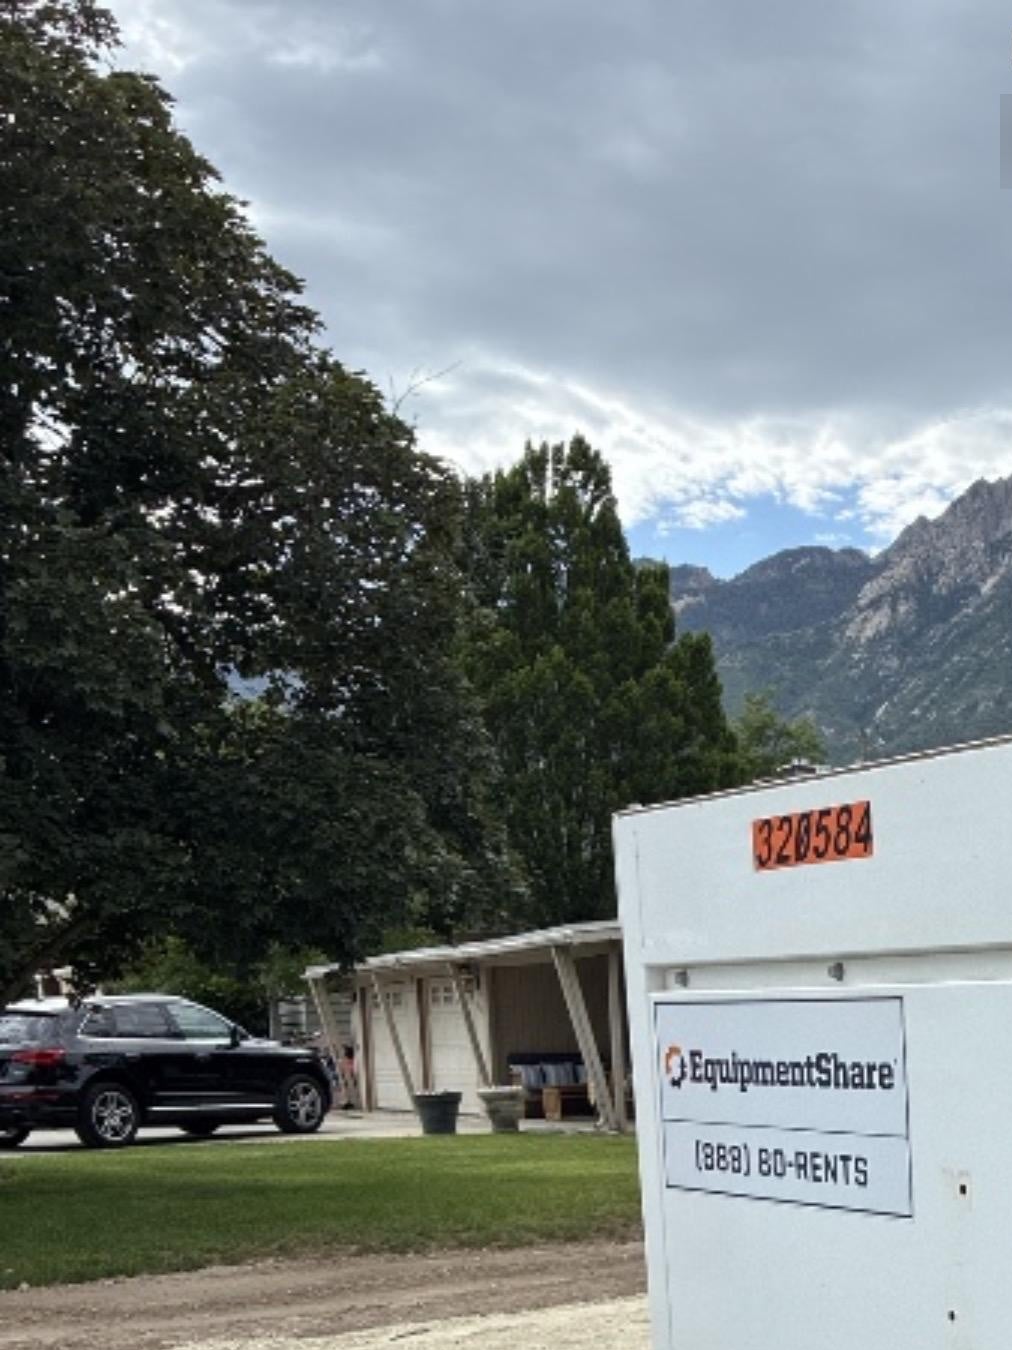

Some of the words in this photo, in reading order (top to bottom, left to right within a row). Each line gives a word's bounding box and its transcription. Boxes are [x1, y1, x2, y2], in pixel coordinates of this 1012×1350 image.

[754, 800, 873, 869] 320584
[689, 1049, 895, 1093] EquipmentShare
[695, 1139, 751, 1177] (888)
[758, 1148, 868, 1188] 80-RENTS
